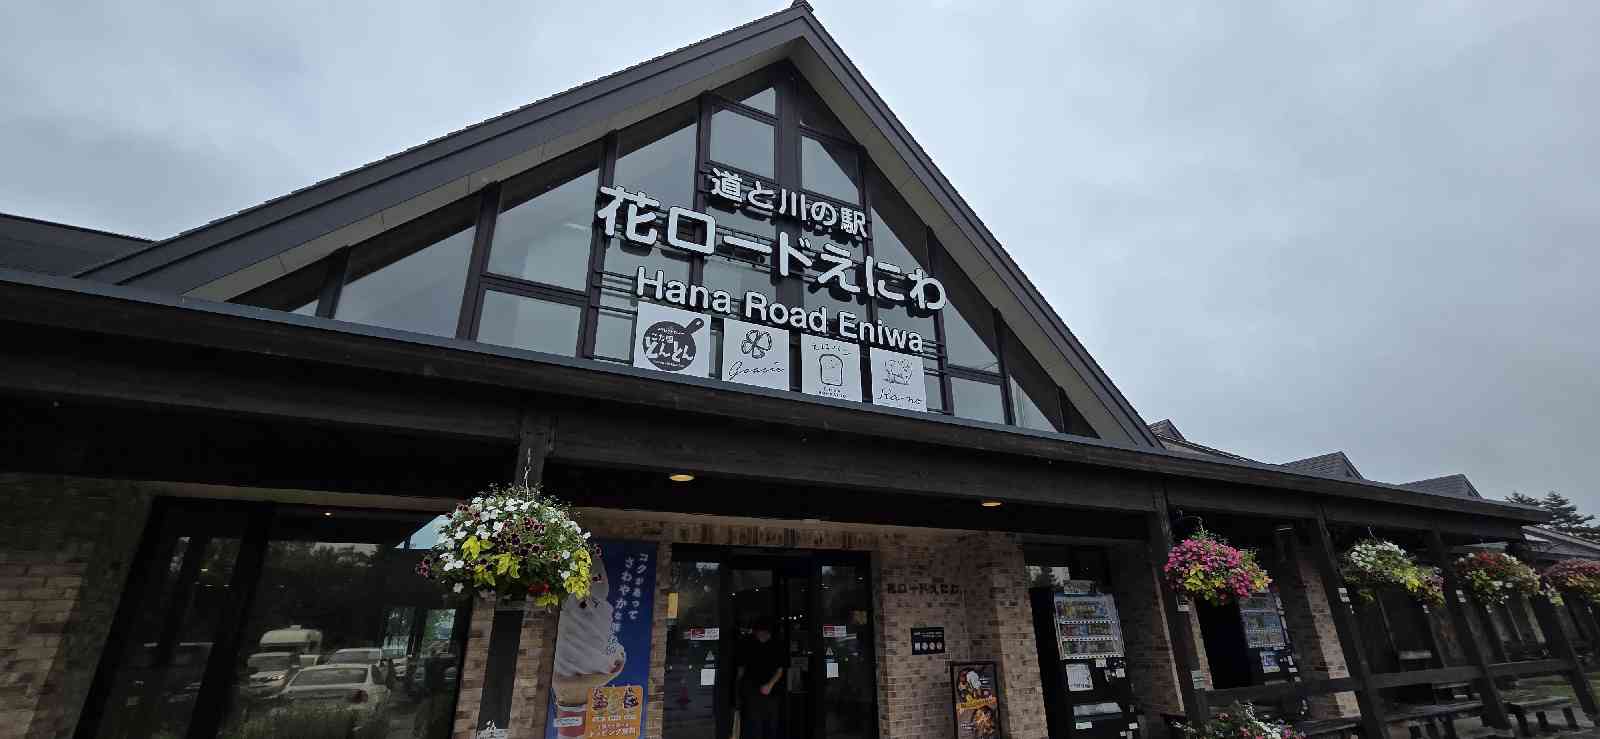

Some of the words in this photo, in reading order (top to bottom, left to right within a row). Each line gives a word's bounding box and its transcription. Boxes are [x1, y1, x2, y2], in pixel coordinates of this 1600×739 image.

[711, 167, 867, 238] 道と川の駅
[598, 184, 947, 311] 花ロードえにわ
[637, 265, 733, 314] Hana
[744, 290, 828, 334] Road
[838, 312, 925, 354] Eniwa
